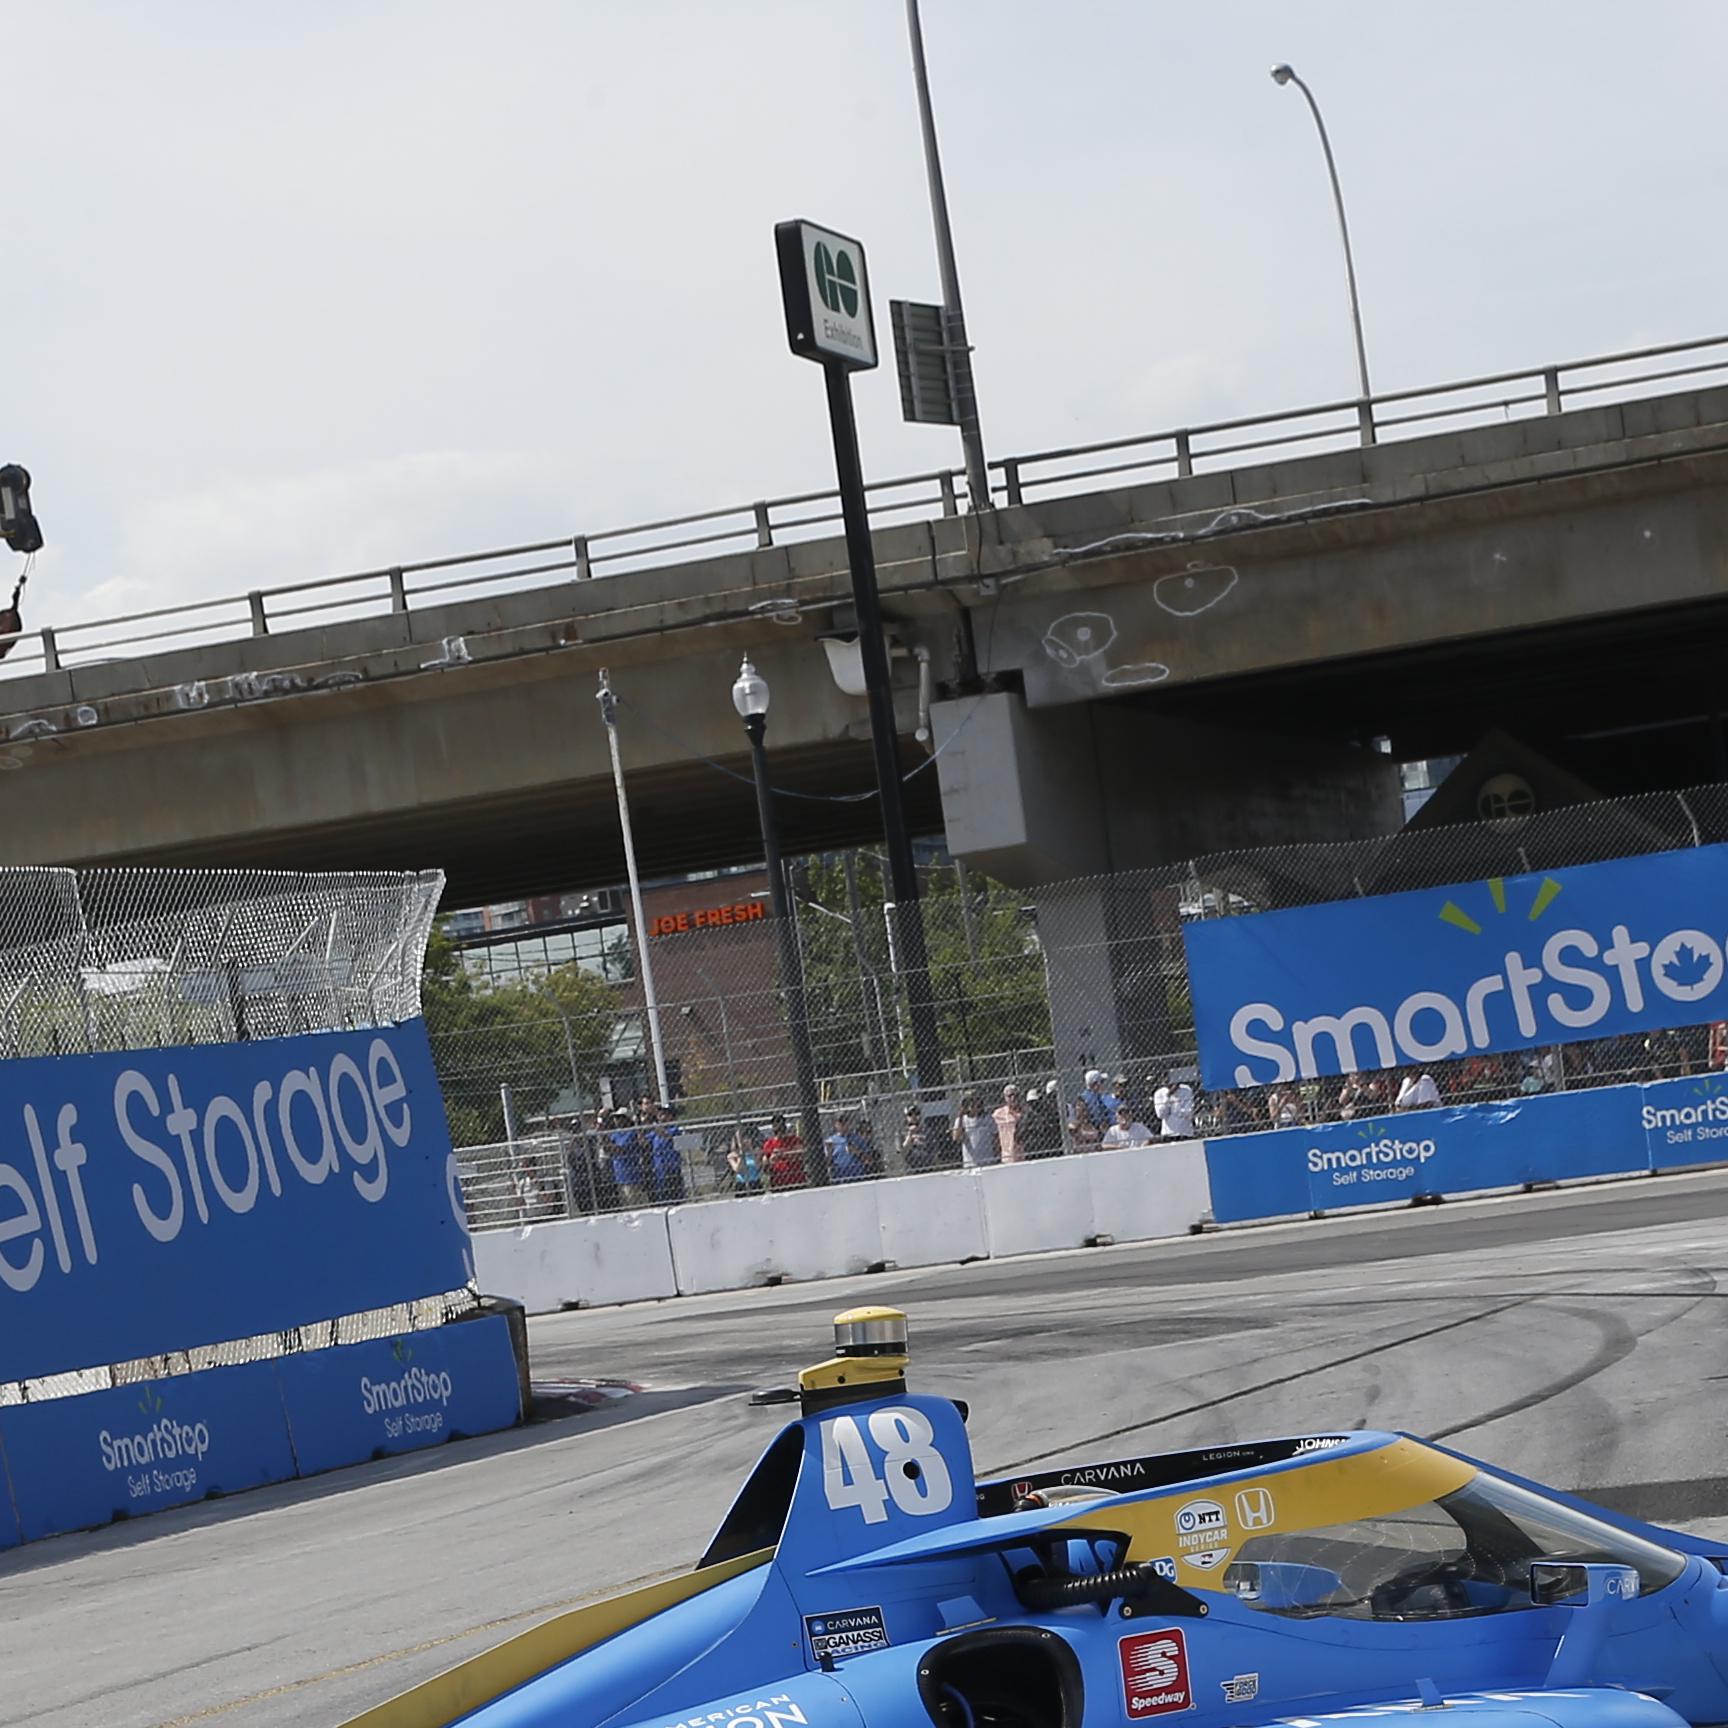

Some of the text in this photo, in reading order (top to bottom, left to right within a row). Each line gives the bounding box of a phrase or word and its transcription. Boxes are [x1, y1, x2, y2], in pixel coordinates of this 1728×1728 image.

[648, 901, 764, 936] JOE FRESH
[113, 1037, 414, 1243] Storage
[1667, 1127, 1695, 1144] Self
[1307, 1137, 1436, 1173] SmartStop
[1332, 1164, 1415, 1187] Self Storage
[360, 1367, 453, 1415] SmartStop
[383, 1411, 444, 1439] Self Storage
[98, 1417, 210, 1472] SmartStop
[1202, 1450, 1240, 1461] LEGION
[819, 1405, 953, 1526] 48
[1060, 1462, 1146, 1486] CARVANA
[127, 1466, 197, 1499] Self Storage
[1197, 1510, 1221, 1525] NTT
[1178, 1529, 1228, 1549] INDYCAR
[826, 1615, 879, 1631] CARVANA
[816, 1641, 886, 1656] ACING
[826, 1629, 884, 1649] GANASSI
[1131, 1689, 1186, 1710] Speedway
